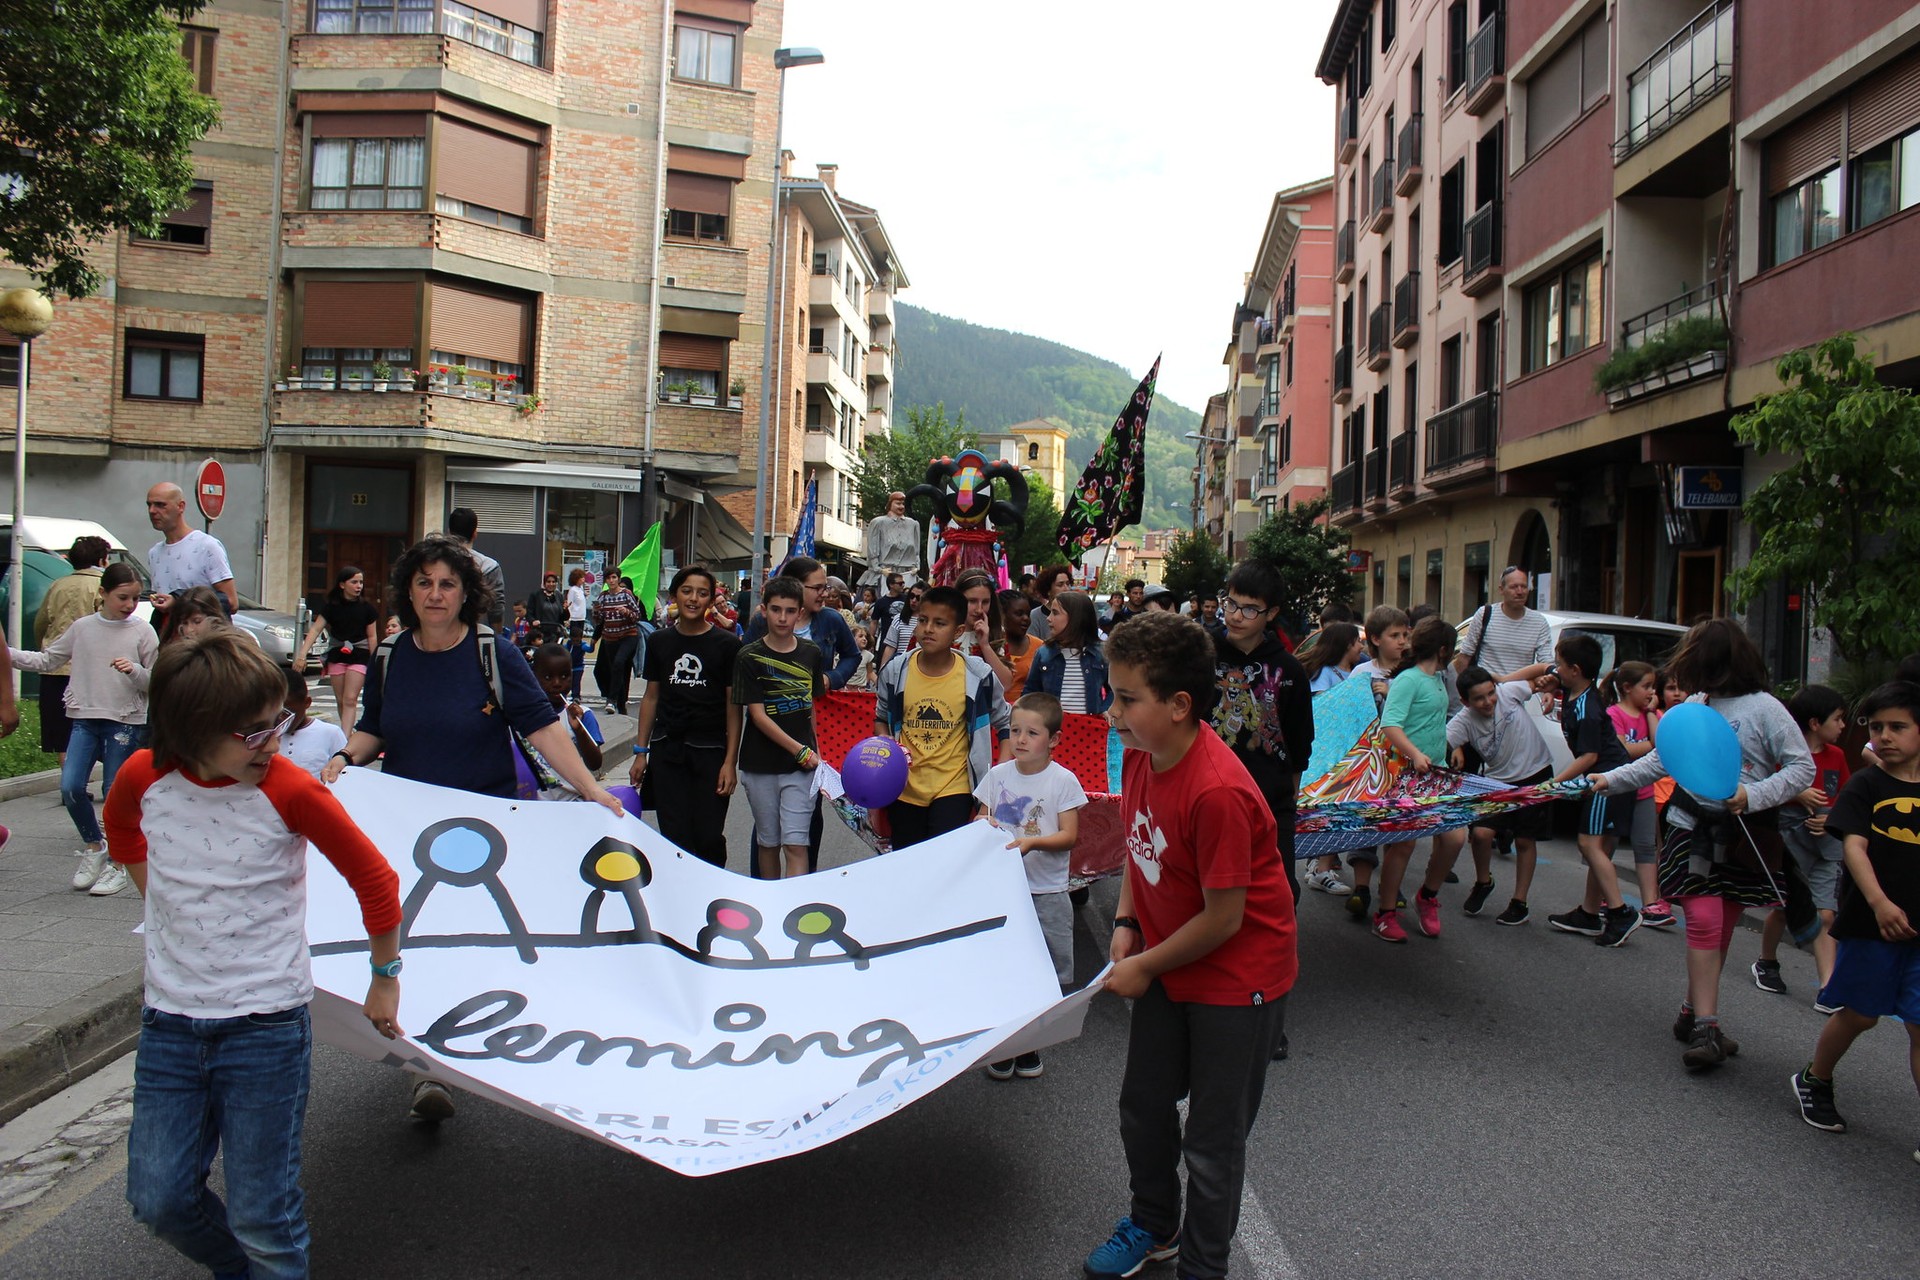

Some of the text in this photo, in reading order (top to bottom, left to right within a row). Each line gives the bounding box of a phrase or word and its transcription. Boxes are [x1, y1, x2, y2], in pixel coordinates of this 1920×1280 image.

[592, 482, 623, 490] GALERIAS
[352, 493, 367, 505] 33
[1687, 493, 1738, 505] TELEBANCO
[766, 699, 804, 715] ESSI
[921, 719, 955, 730] TERRITORY
[540, 1102, 670, 1130] RRI
[604, 1131, 731, 1148] MASA
